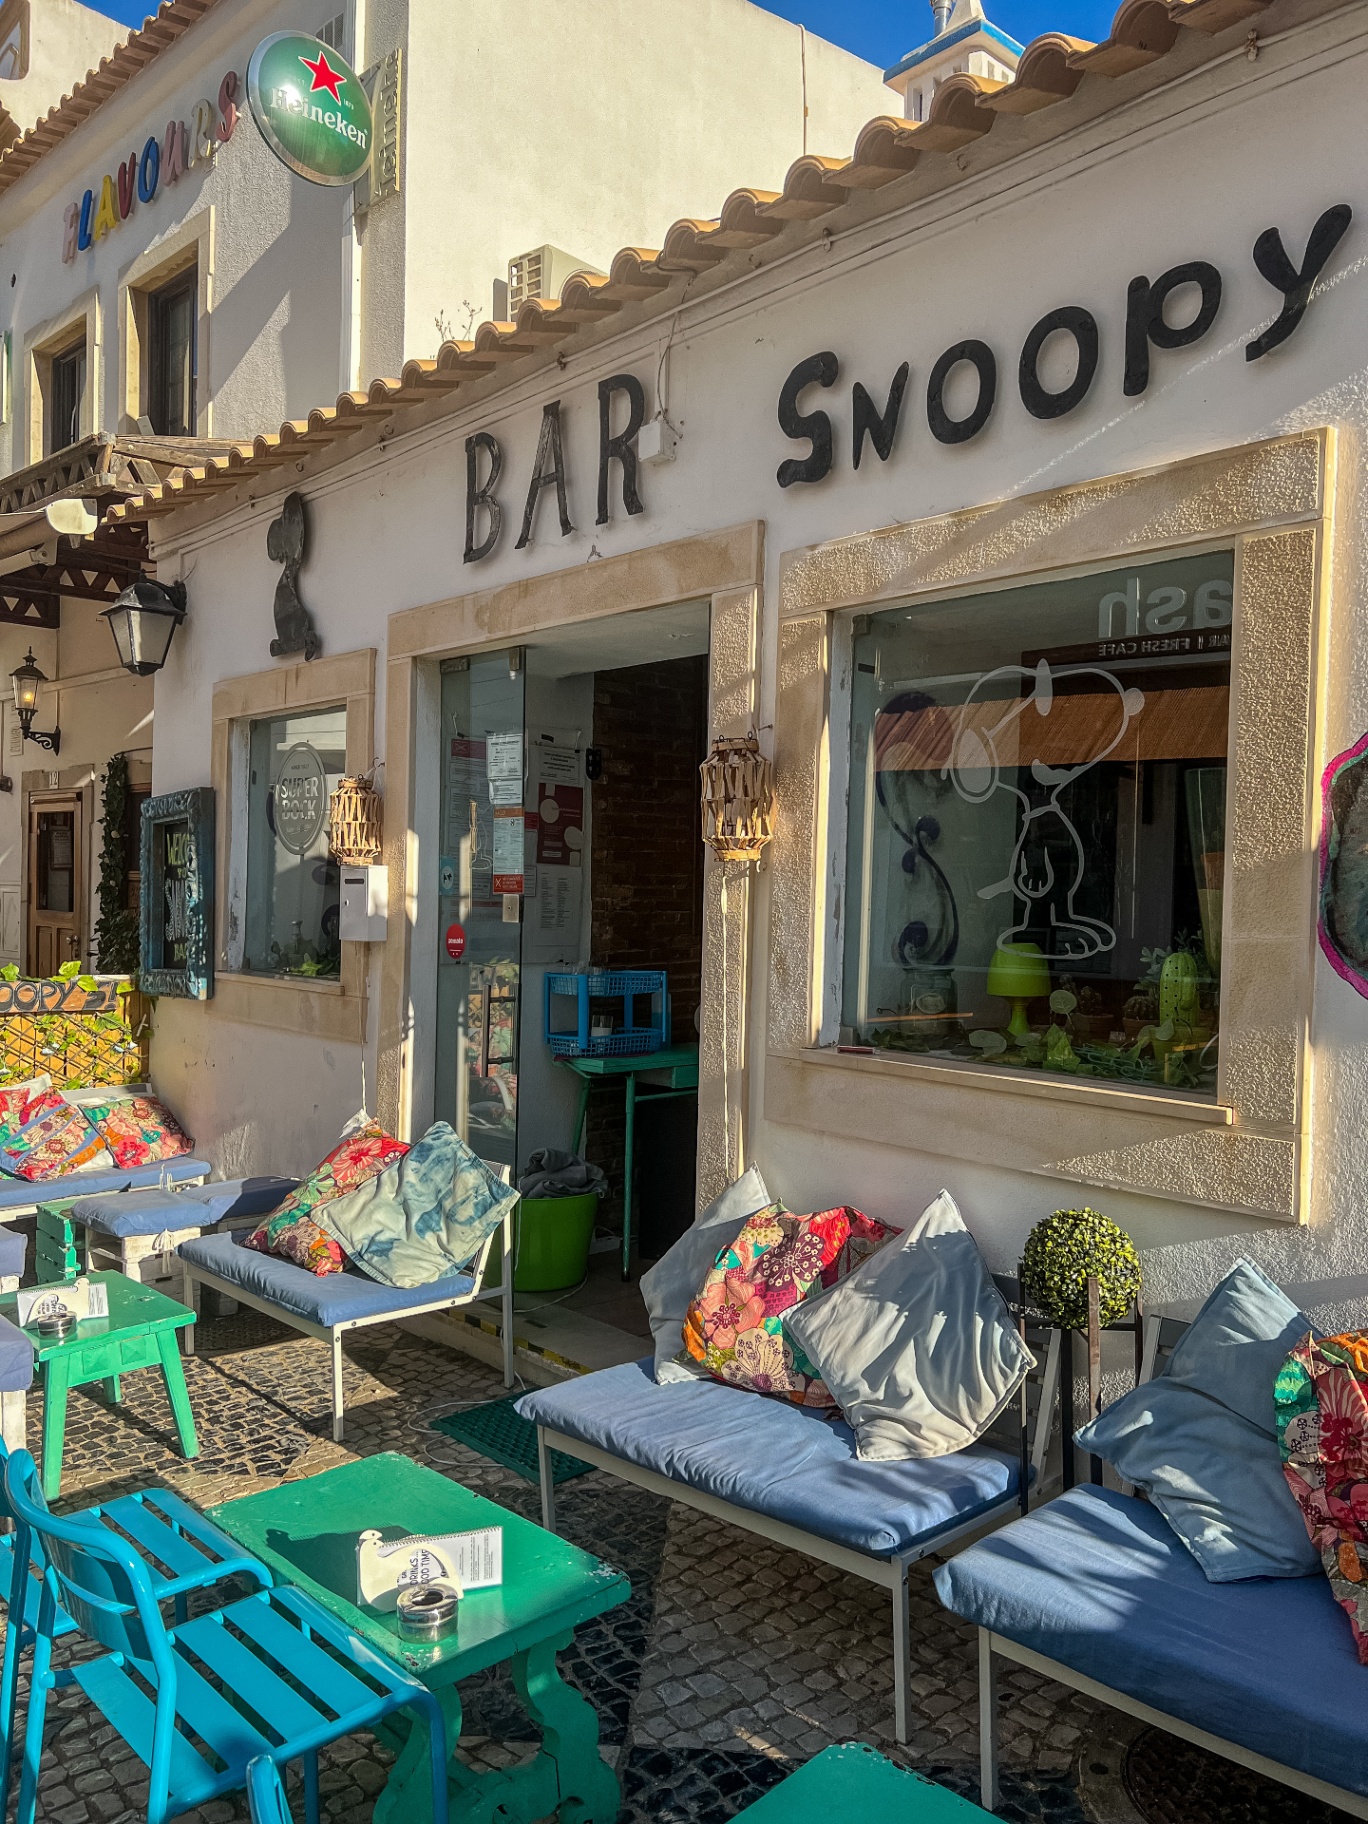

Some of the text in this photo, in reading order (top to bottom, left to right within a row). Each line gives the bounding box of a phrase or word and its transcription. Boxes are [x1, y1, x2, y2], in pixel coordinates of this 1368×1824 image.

[270, 87, 367, 149] Heineken
[62, 71, 237, 264] FLAVOURS
[463, 374, 645, 564] BAR
[281, 777, 319, 798] SUPER
[281, 799, 317, 820] BOCK
